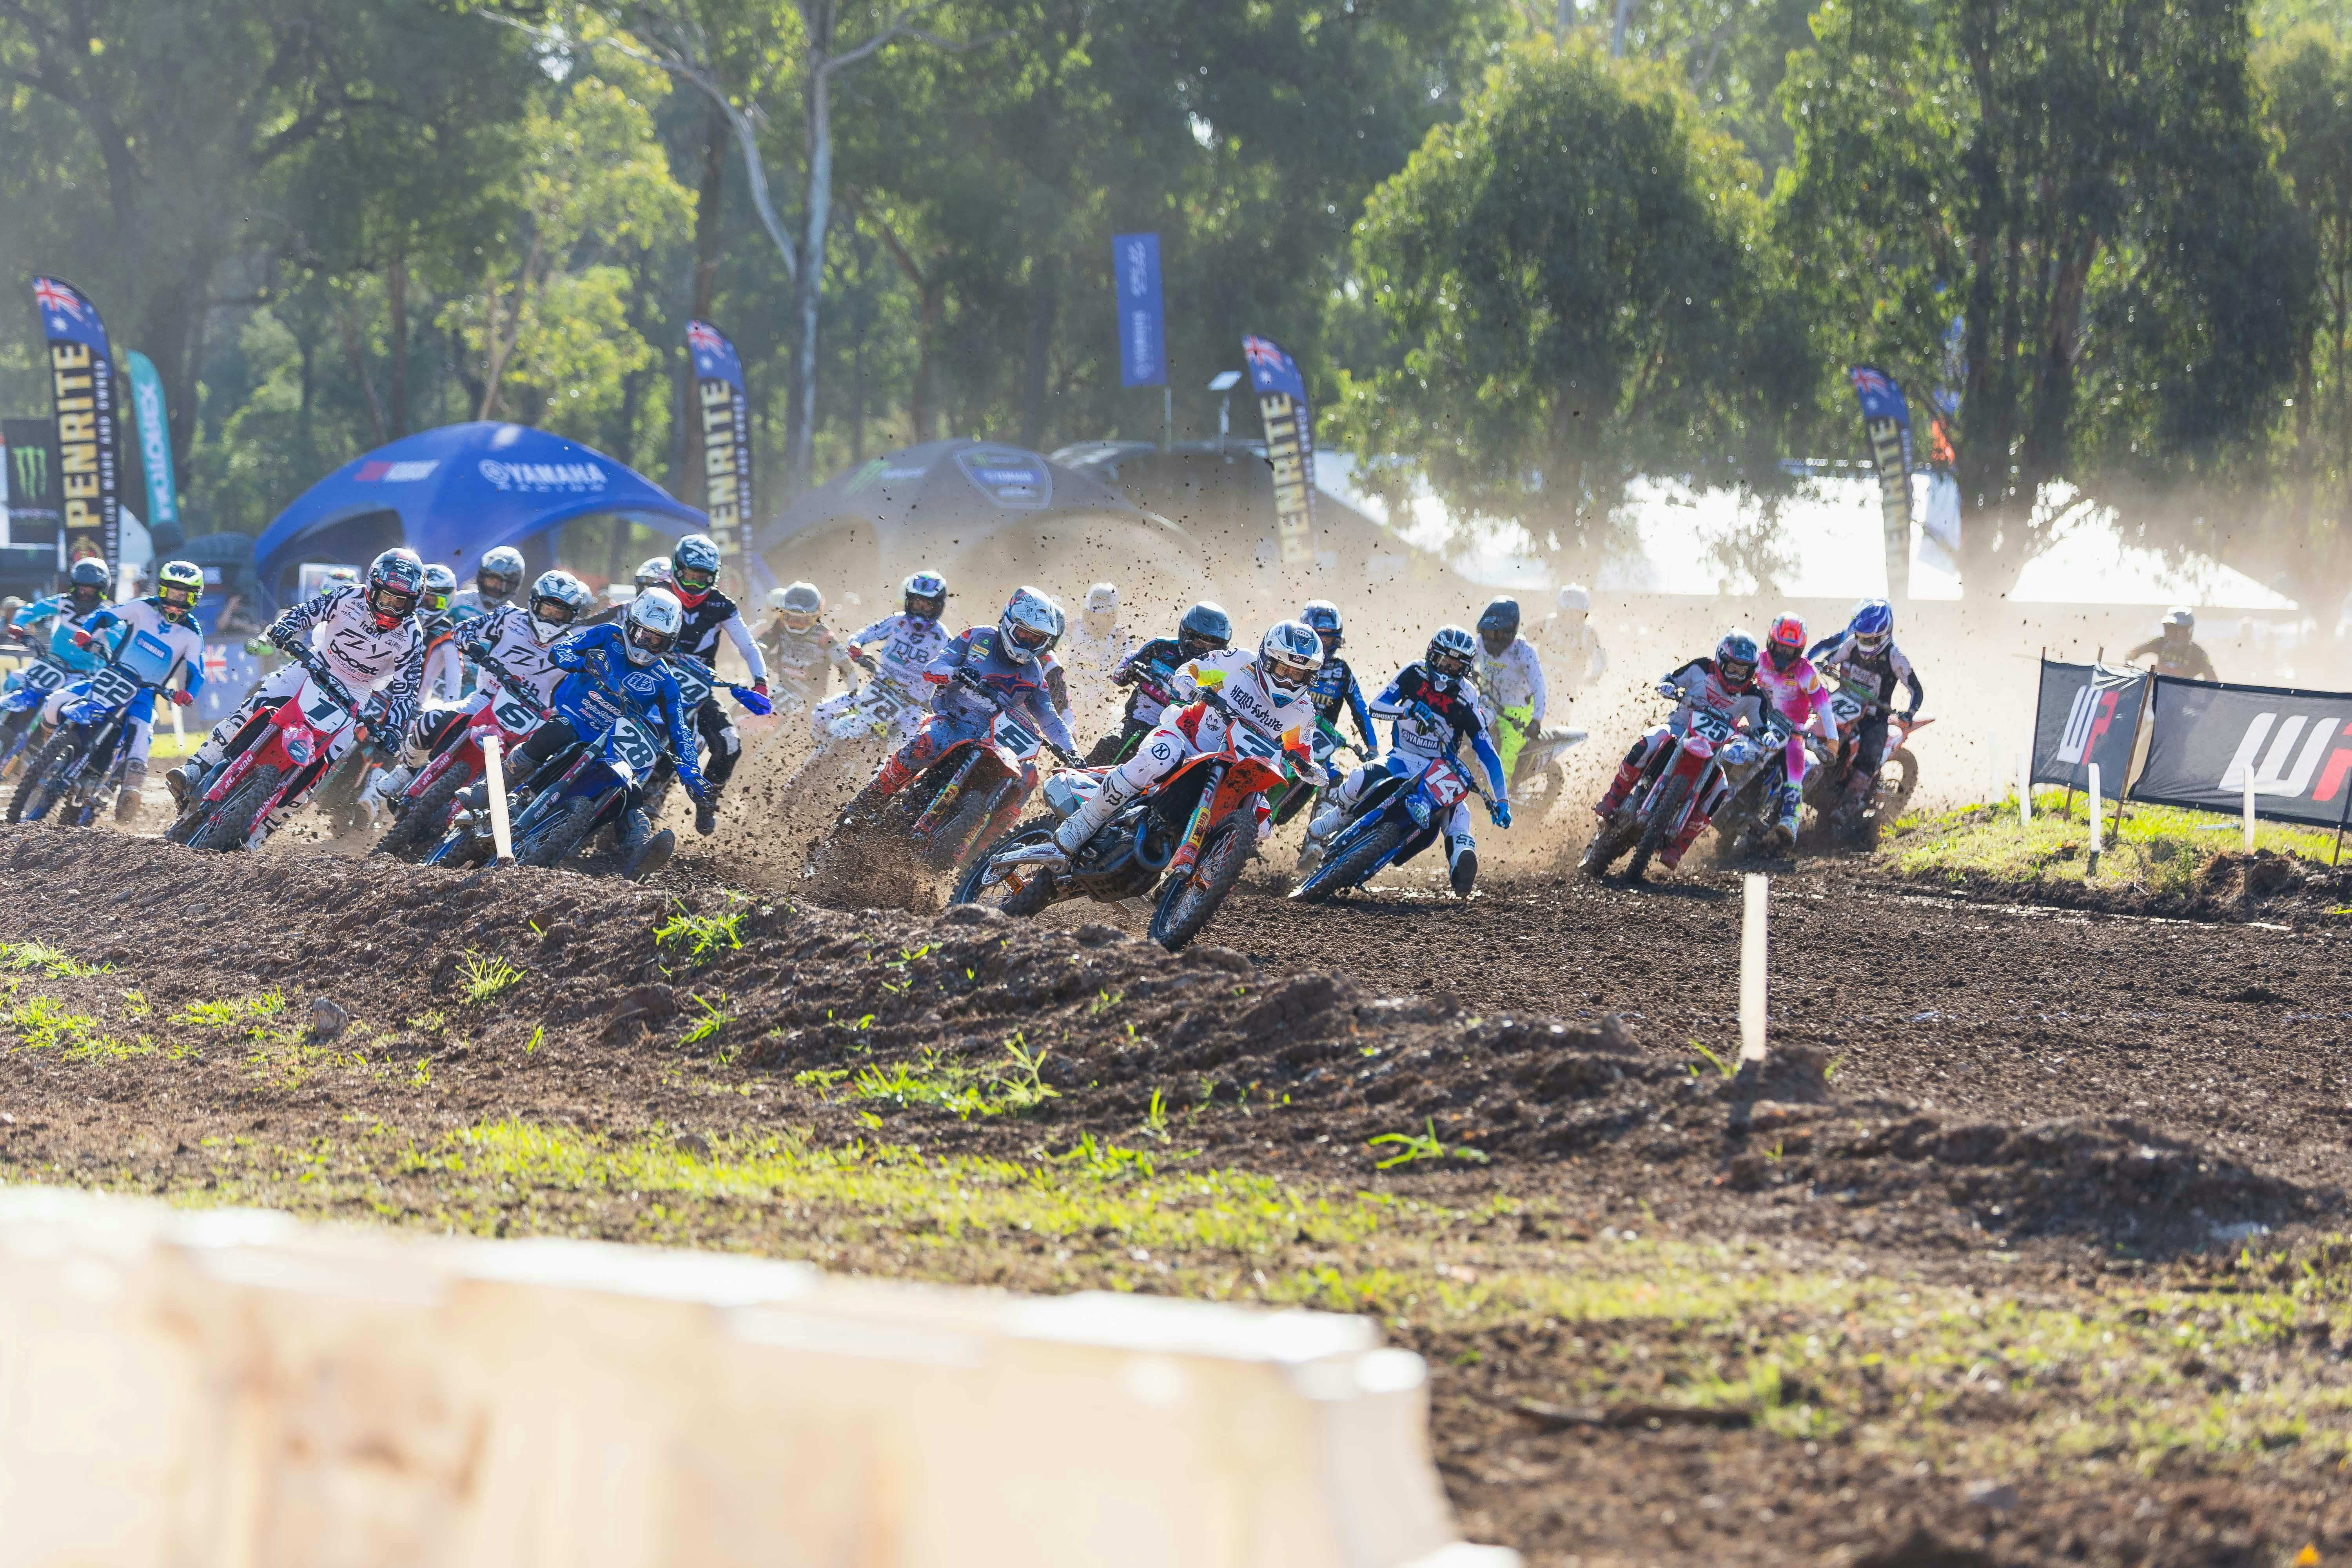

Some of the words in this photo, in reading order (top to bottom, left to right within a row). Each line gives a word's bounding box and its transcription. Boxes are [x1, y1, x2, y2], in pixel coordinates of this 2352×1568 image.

[94, 359, 110, 410] OWNED
[53, 343, 102, 528] PENRITE
[98, 416, 113, 445] AND
[100, 450, 115, 490] MADE
[504, 462, 608, 485] YAMAHA
[700, 379, 741, 558] PENRITE
[1260, 392, 1314, 564] PENRITE
[143, 641, 165, 659] YAMAHA
[330, 639, 379, 676] boost
[332, 655, 357, 674] mobile
[25, 663, 61, 688] 40
[92, 671, 134, 705] 22
[305, 697, 339, 722] 1
[495, 702, 534, 729] 5
[1371, 712, 1399, 721] COMISKEY
[994, 724, 1036, 755] 5
[1409, 735, 1438, 750] YAMAHA
[1693, 716, 1727, 741] 25
[611, 725, 653, 768] 28
[1234, 734, 1276, 759] 3
[225, 753, 254, 789] DUNOP
[423, 755, 450, 785] DUOP
[1425, 764, 1465, 804] 14
[1192, 811, 1210, 843] PIRELI
